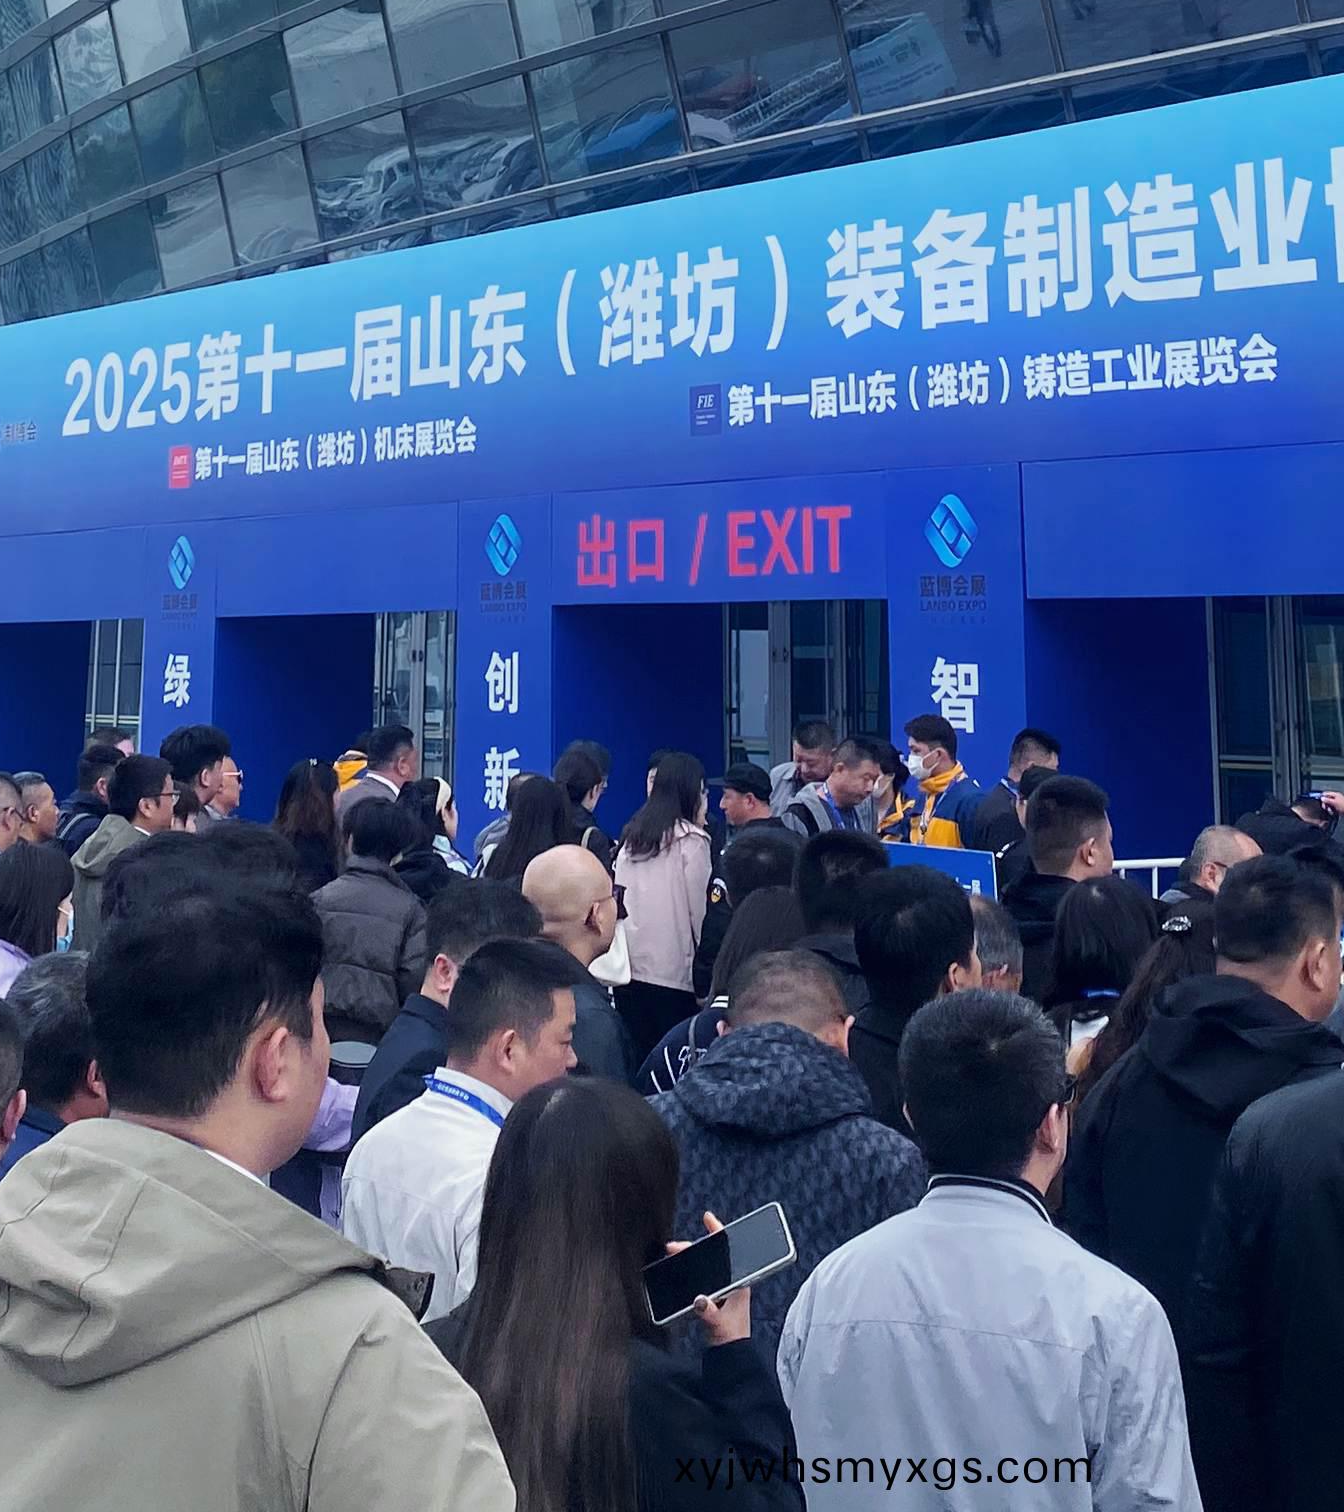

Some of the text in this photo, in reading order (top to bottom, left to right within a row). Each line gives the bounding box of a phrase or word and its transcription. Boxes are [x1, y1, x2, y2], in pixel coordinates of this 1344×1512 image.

[727, 332, 1278, 427] 第十一届山东（潍坊）铸造工业展览会
[194, 415, 477, 481] 第十一届山东（潍坊）机床展览会
[577, 514, 665, 588] 出口
[728, 505, 852, 576] EXIT
[919, 575, 986, 598] 蓝博会展
[958, 599, 987, 611] EXPO
[162, 653, 192, 709] 绿
[930, 655, 980, 734] 智
[483, 650, 521, 813] 创新
